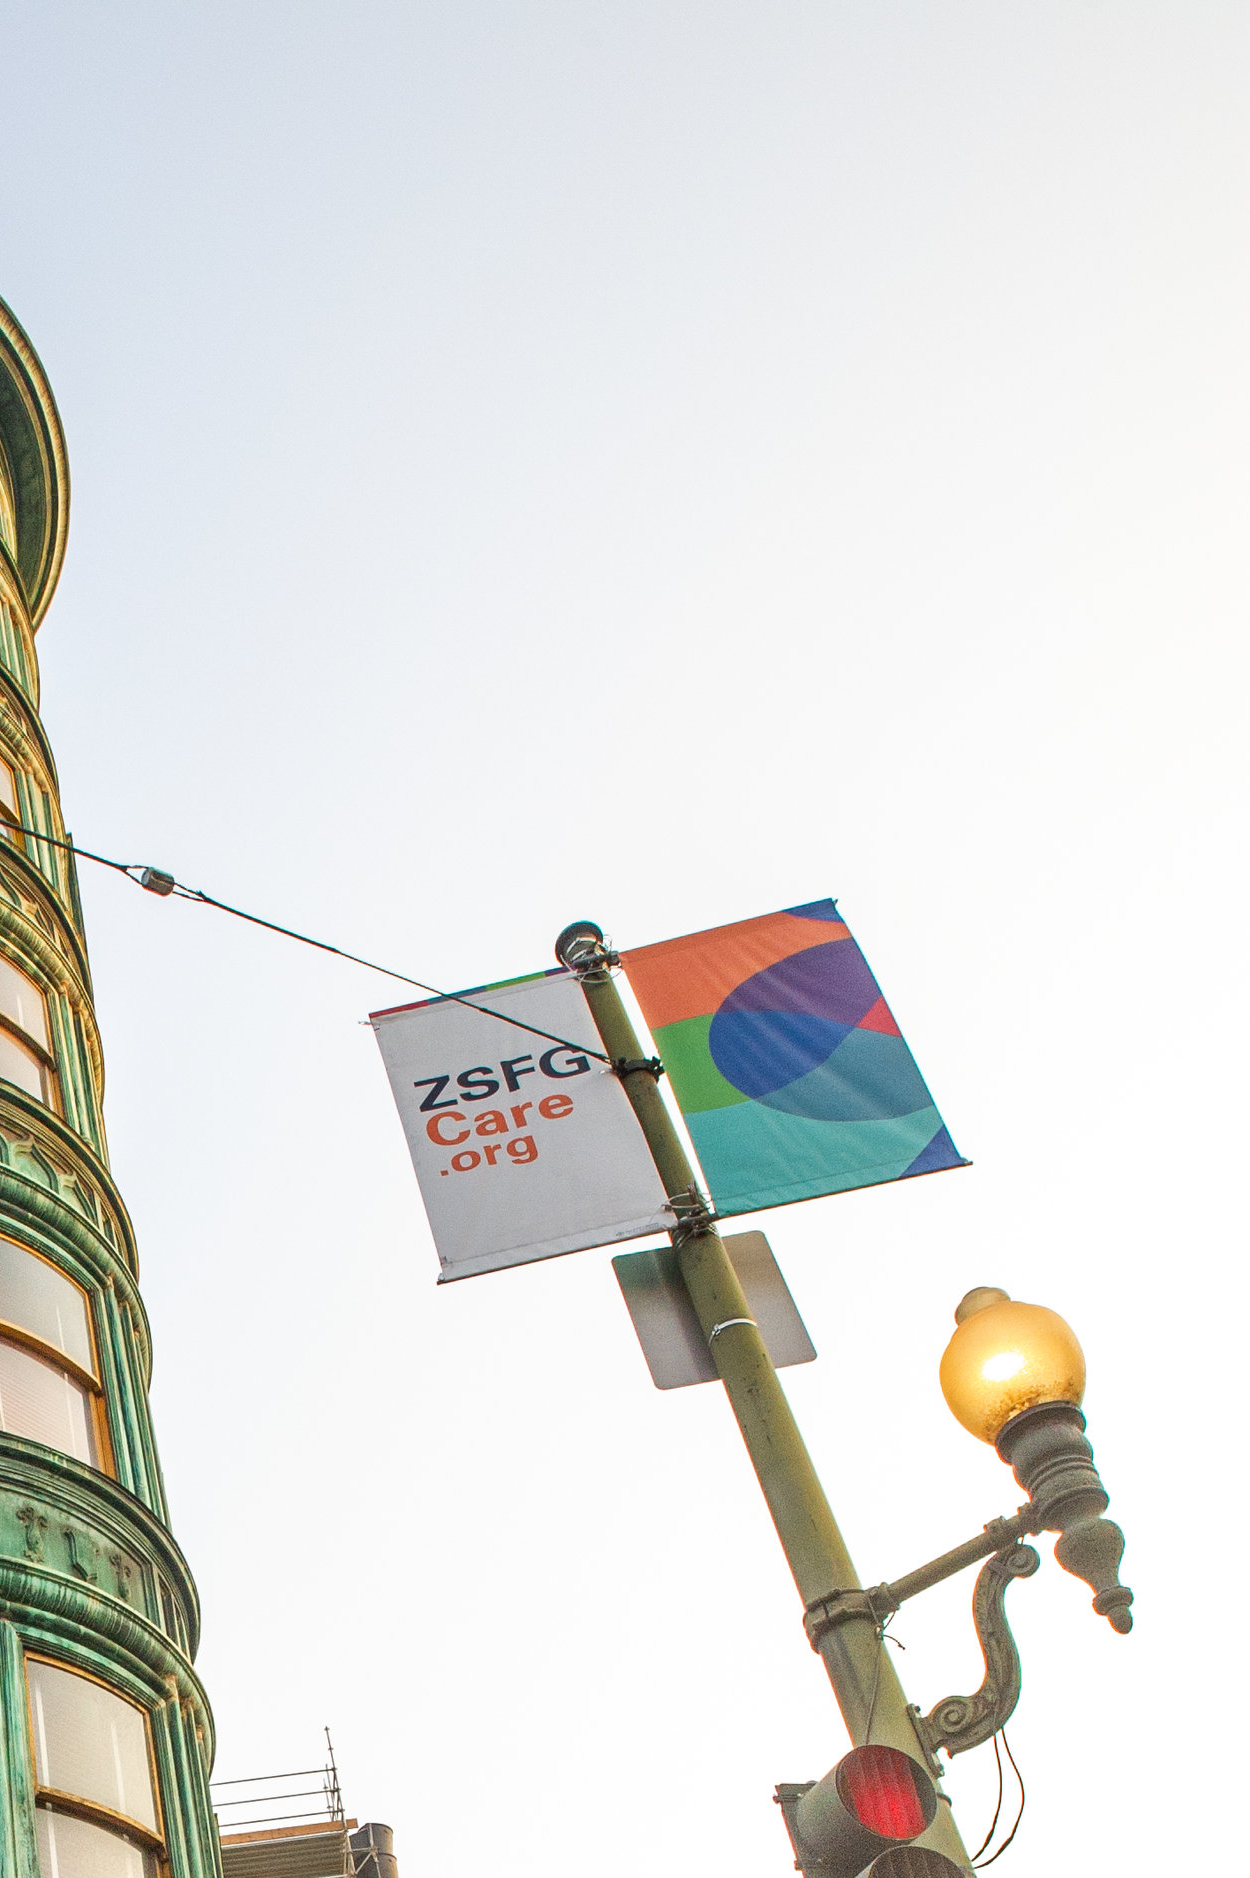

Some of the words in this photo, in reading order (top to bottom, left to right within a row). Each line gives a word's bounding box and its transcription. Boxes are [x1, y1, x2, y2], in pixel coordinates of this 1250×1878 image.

[412, 1046, 591, 1113] ZSFG
[424, 1092, 574, 1147] Care
[439, 1132, 539, 1177] .org
